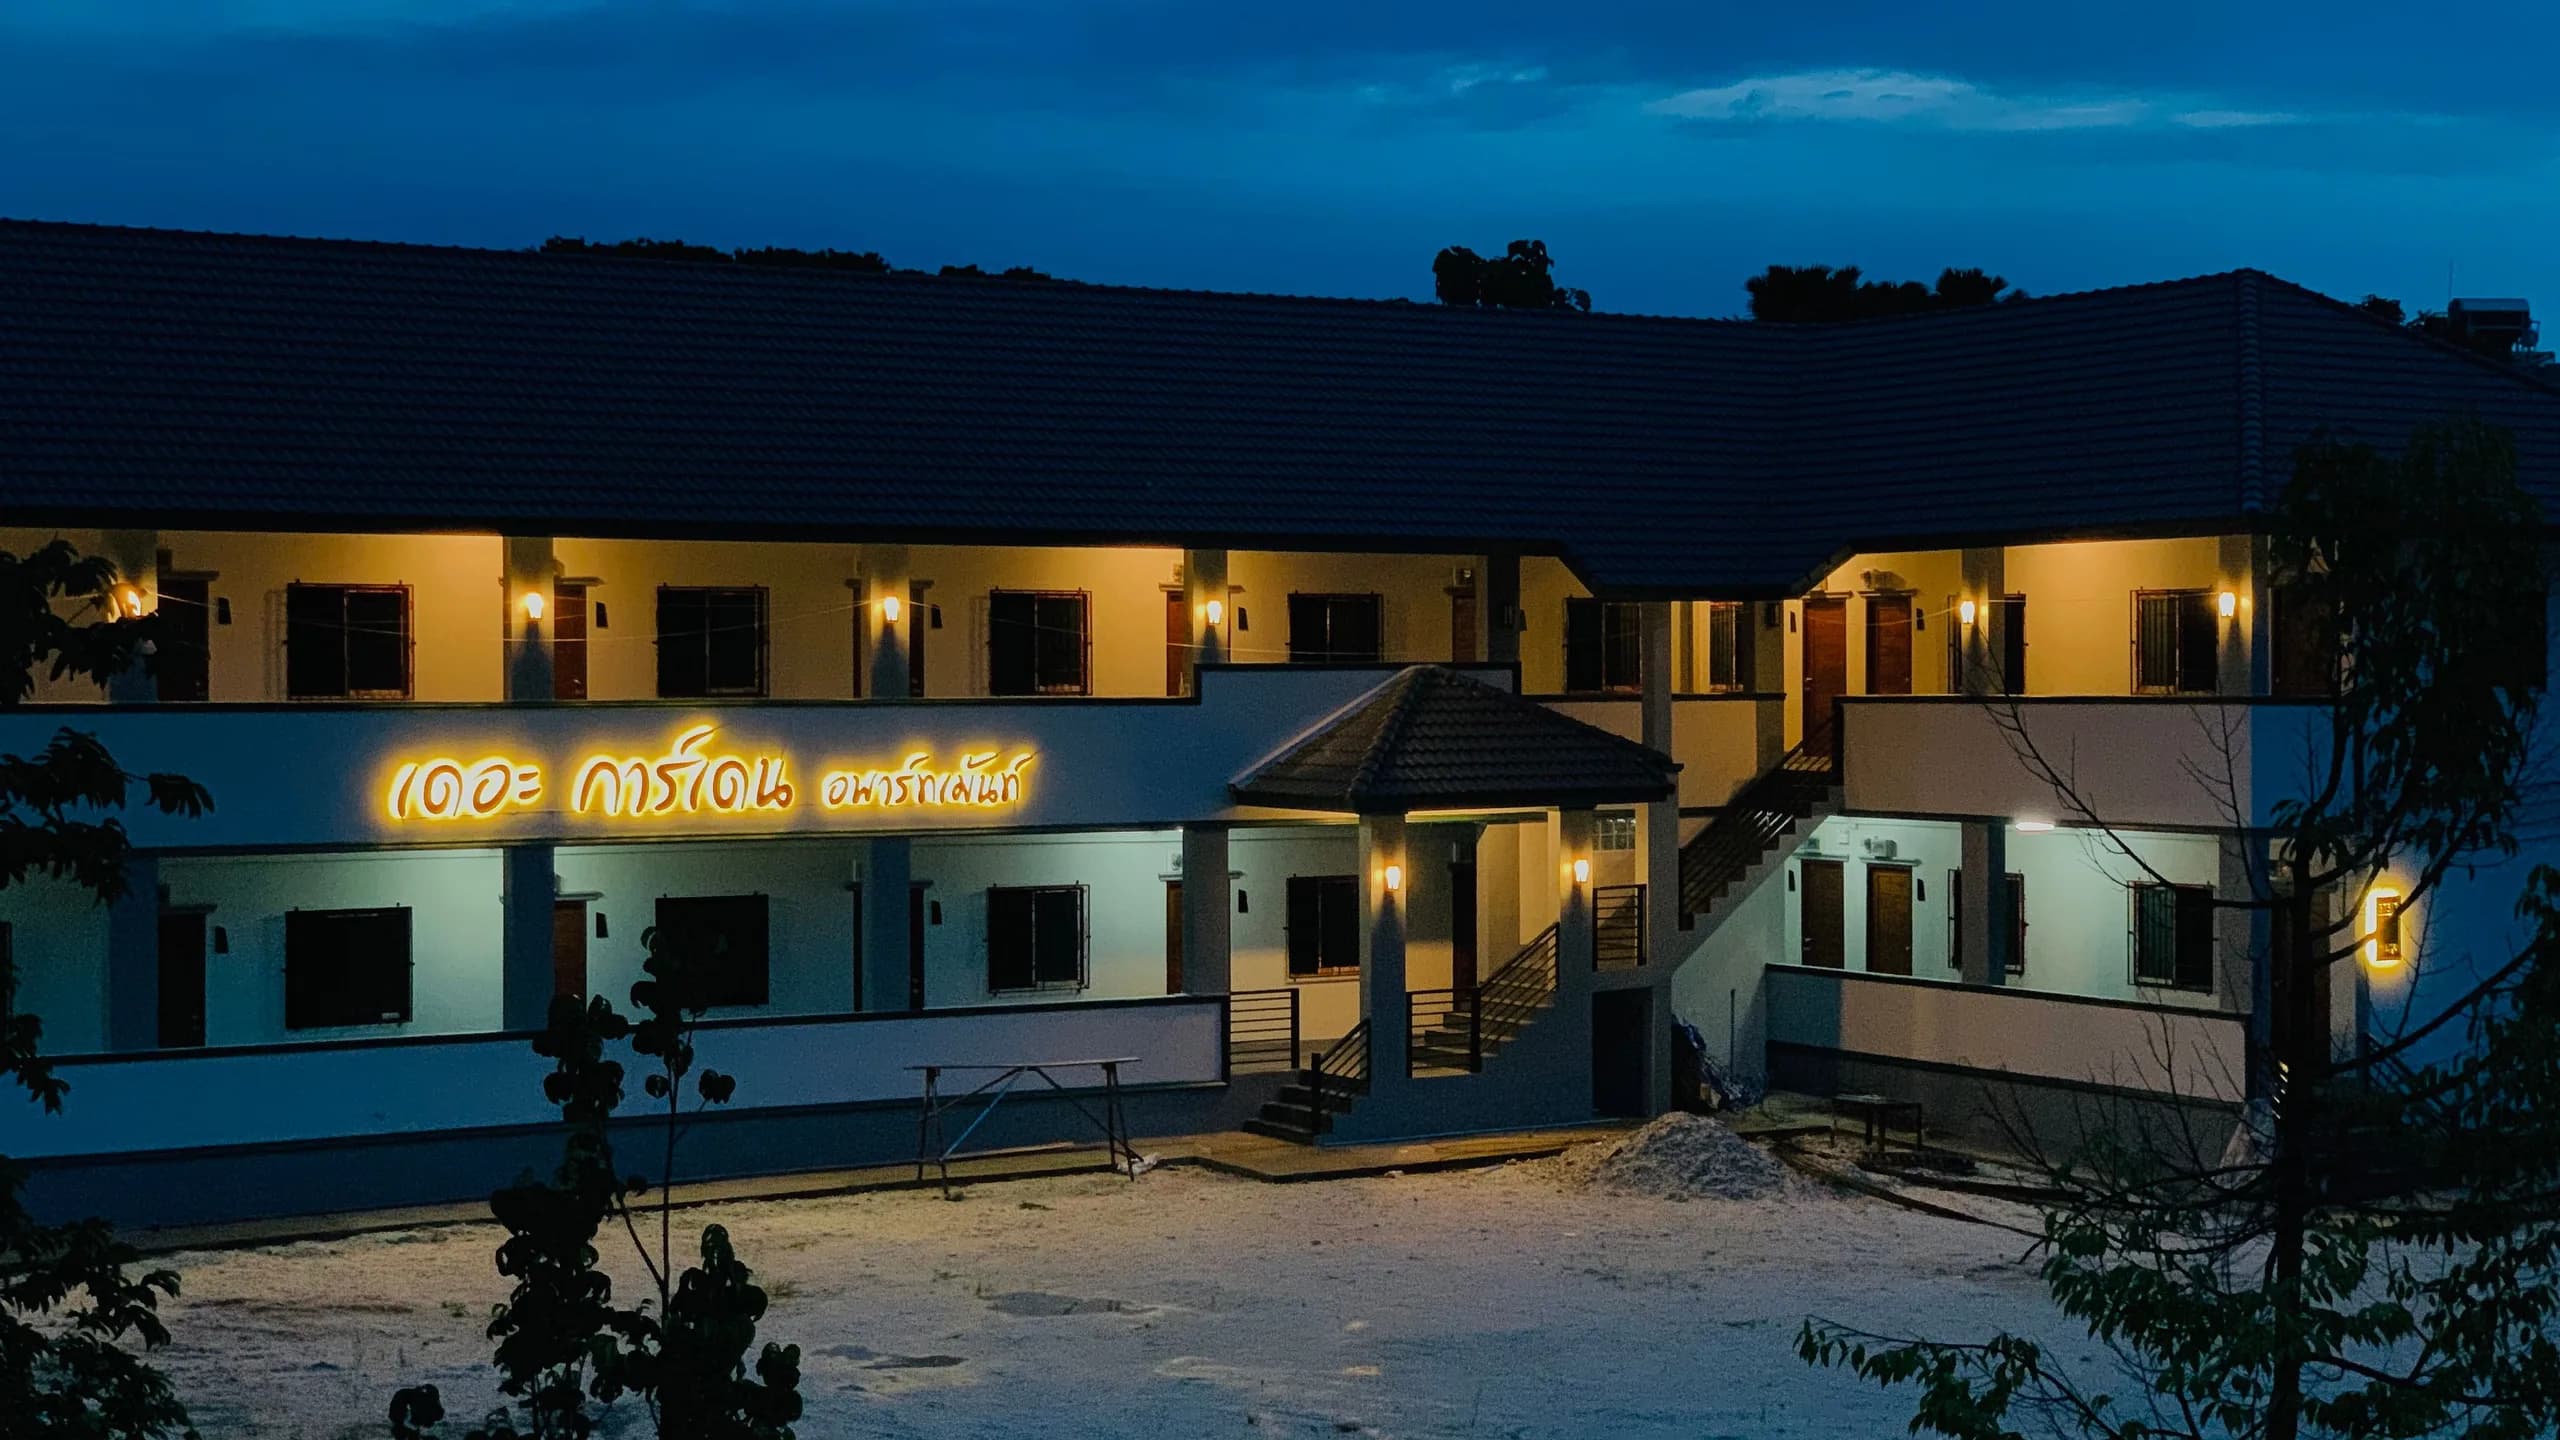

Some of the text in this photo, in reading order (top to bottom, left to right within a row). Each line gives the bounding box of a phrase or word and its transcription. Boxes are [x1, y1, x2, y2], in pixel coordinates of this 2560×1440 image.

[392, 762, 544, 819] เดอะ
[575, 723, 796, 816] การ์เดน
